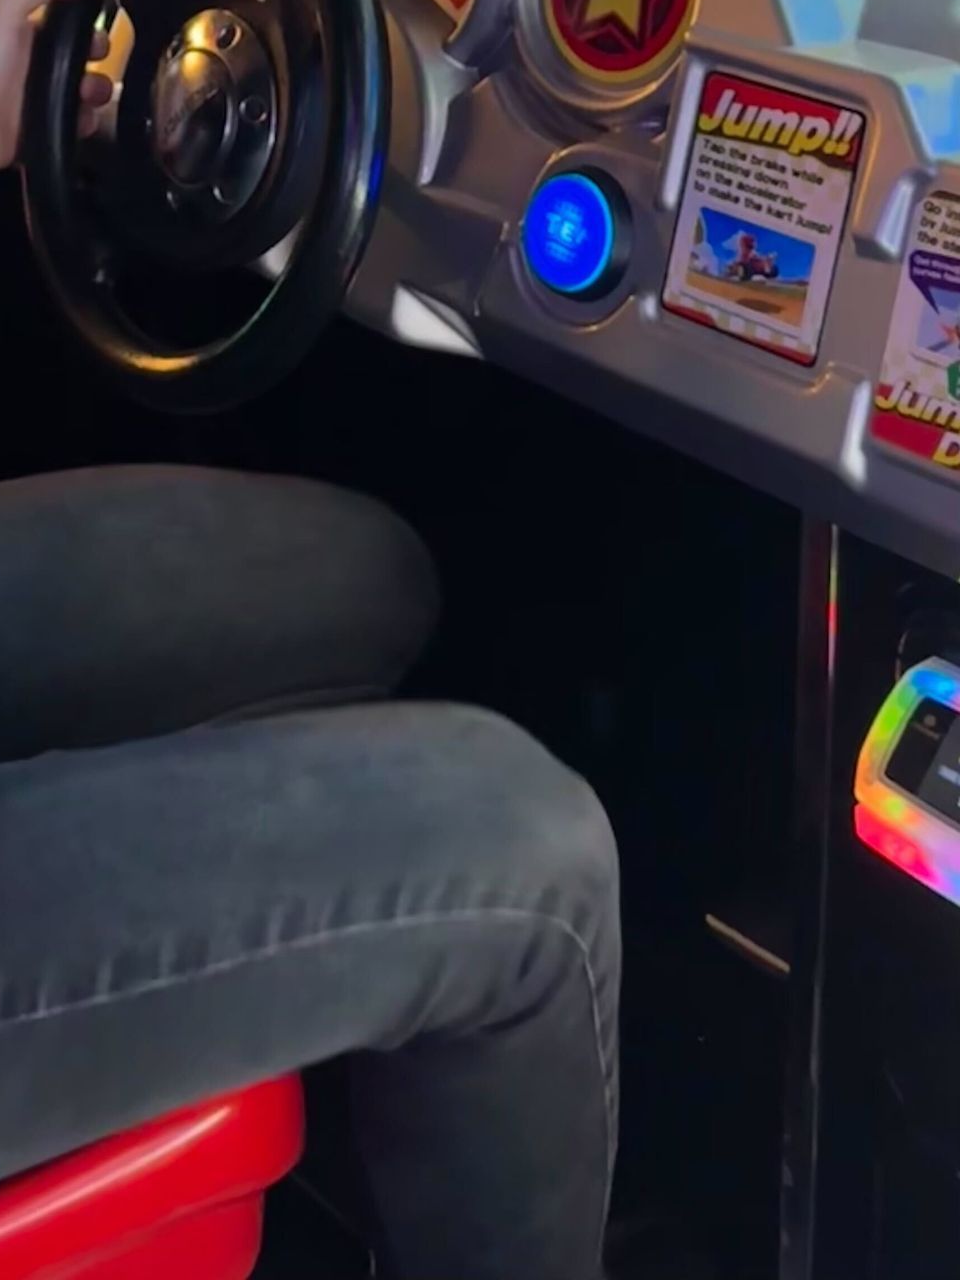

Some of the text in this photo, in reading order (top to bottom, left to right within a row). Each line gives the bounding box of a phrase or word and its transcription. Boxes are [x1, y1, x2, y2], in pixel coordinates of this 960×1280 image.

[697, 87, 863, 156] Jump!!
[698, 154, 790, 190] pressing down
[729, 147, 748, 162] the
[750, 154, 788, 174] brake
[792, 168, 825, 187] while
[693, 179, 834, 236] to make the kart jump!
[695, 168, 808, 211] on the accelerator
[922, 200, 942, 215] Go
[917, 230, 938, 246] the
